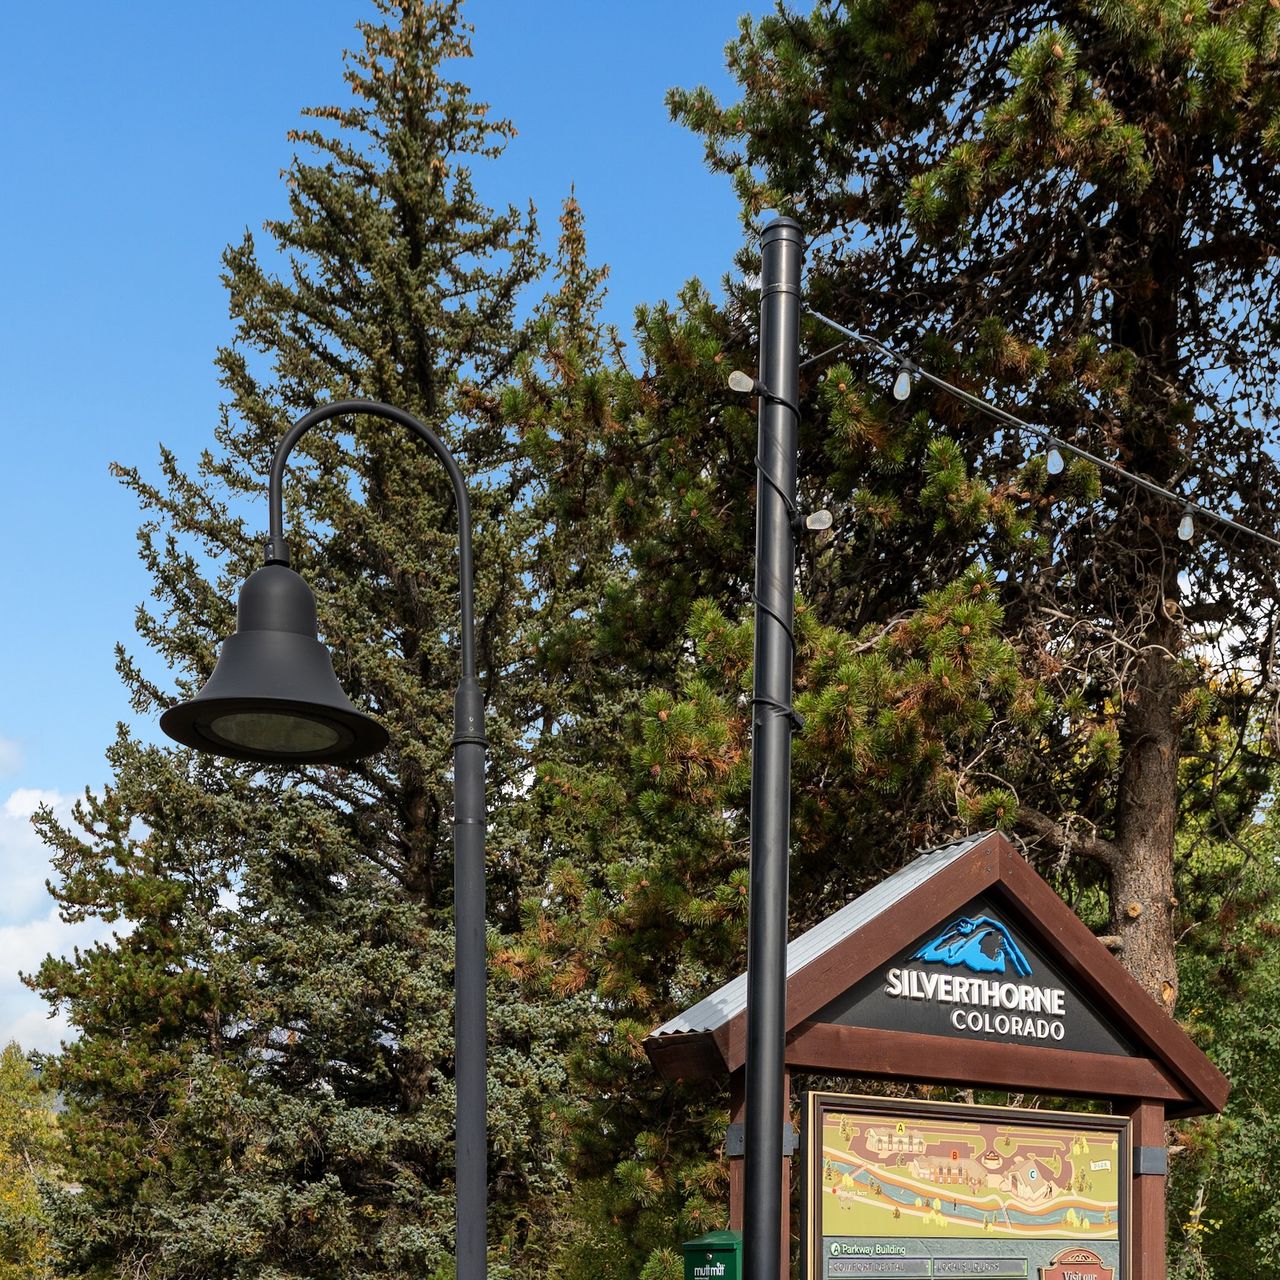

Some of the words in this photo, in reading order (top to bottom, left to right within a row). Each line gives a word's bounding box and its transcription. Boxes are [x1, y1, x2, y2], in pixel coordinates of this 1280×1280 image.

[884, 967, 1066, 1015] SILVERTHORNE
[950, 1009, 1065, 1041] COLORADO
[897, 1124, 904, 1132] A
[952, 1152, 958, 1160] B
[1030, 1170, 1036, 1179] C
[842, 1244, 875, 1255] Parkway
[875, 1243, 906, 1256] Building
[833, 1262, 873, 1272] COMFORT
[874, 1262, 905, 1272] DENTAL
